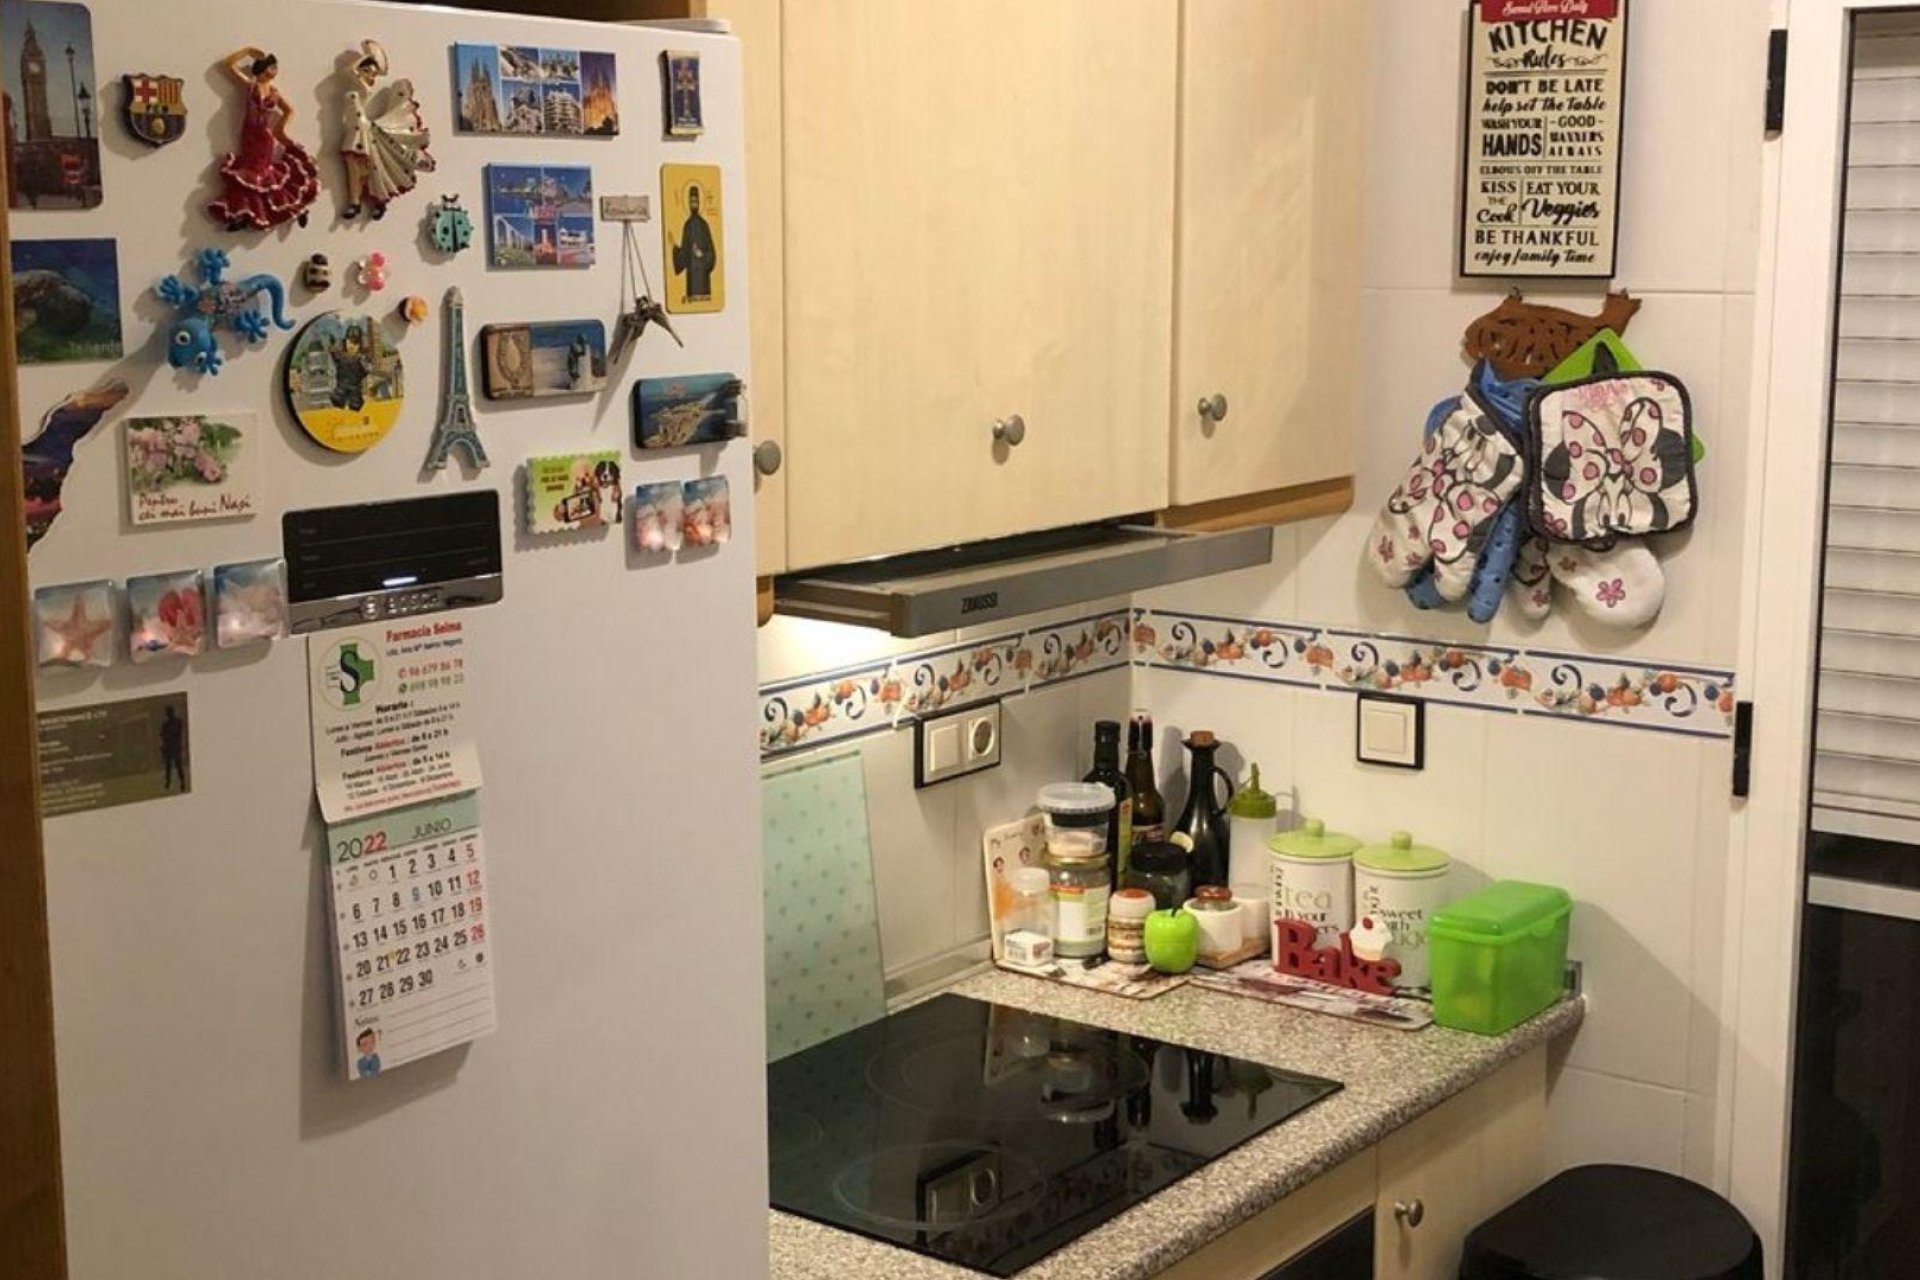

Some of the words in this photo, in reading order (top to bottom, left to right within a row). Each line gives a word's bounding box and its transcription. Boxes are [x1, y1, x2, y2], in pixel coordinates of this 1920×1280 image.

[1488, 19, 1608, 53] KITCHEN
[1522, 44, 1566, 69] Rules
[1486, 80, 1532, 95] DON'T
[1537, 80, 1559, 94] BE
[1564, 79, 1605, 93] LATE
[1482, 98, 1513, 117] help
[1516, 98, 1539, 112] set
[1542, 96, 1565, 112] the
[1558, 115, 1596, 128] GOOD
[1482, 133, 1543, 157] HANDS
[1480, 181, 1517, 193] KISS
[1526, 181, 1553, 195] EAT
[1556, 181, 1601, 196] YOUR
[1476, 203, 1518, 223] Cook
[1520, 198, 1601, 226] Veggies
[1475, 230, 1497, 245] BE
[1501, 230, 1600, 246] THANKFUL
[1474, 249, 1512, 267] enjoy
[1510, 247, 1560, 268] family
[960, 592, 998, 615] ZANUSSI
[386, 623, 432, 643] Farmacia
[413, 818, 451, 838] JUNIO
[337, 831, 388, 863] 2022
[389, 865, 396, 879] 1
[408, 858, 417, 874] 2
[427, 853, 437, 869] 3
[448, 848, 456, 862] 4
[466, 843, 475, 858] 5
[352, 903, 361, 919] 6
[373, 897, 380, 913] 7
[392, 891, 400, 908] 8
[411, 886, 420, 901] 9
[427, 880, 443, 896] 10
[448, 875, 462, 891] 11
[467, 869, 480, 885] 12
[352, 931, 368, 948] 13
[374, 925, 388, 942] 14
[393, 919, 408, 936] 15
[412, 913, 427, 930] 16
[431, 907, 445, 924] 17
[451, 902, 465, 918] 18
[469, 896, 482, 913] 19
[1380, 908, 1423, 920] sweet
[355, 959, 372, 978] 20
[376, 954, 391, 971] 21
[396, 947, 411, 965] 22
[415, 941, 430, 959] 23
[434, 935, 449, 953] 24
[453, 929, 468, 947] 25
[470, 923, 485, 941] 26
[1274, 918, 1402, 996] Bake
[359, 988, 374, 1006] 27
[378, 982, 395, 1000] 28
[399, 975, 414, 993] 29
[417, 969, 433, 987] 30
